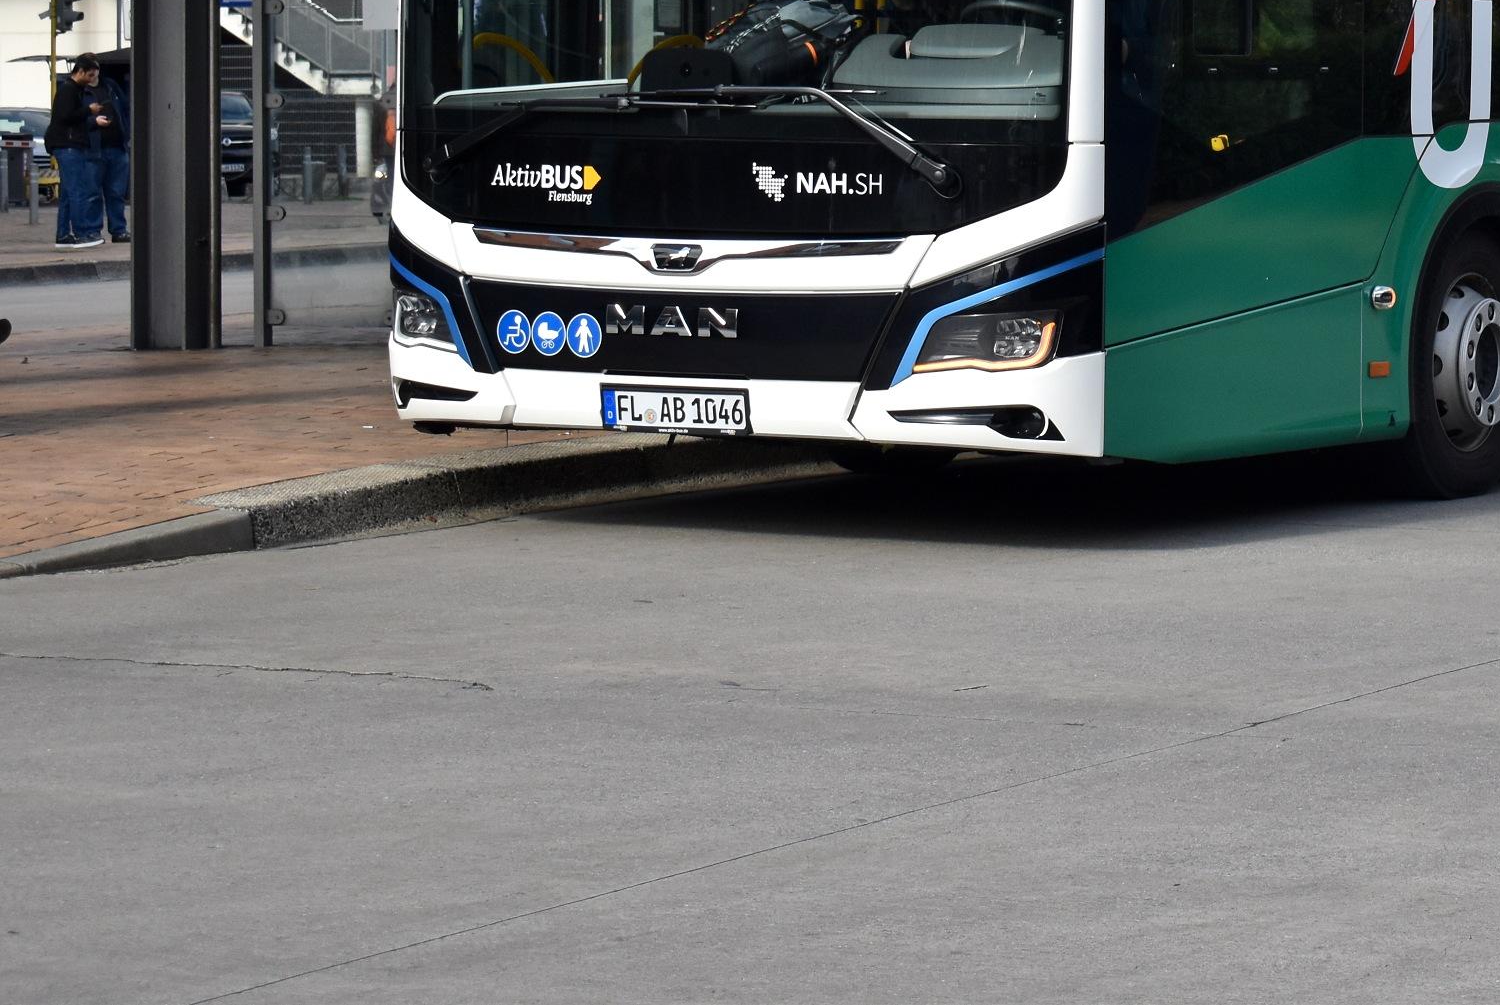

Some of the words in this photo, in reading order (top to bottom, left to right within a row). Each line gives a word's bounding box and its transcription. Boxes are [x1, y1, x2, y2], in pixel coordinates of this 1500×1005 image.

[490, 162, 584, 190] AktivBUS
[796, 172, 883, 195] NAH.SH
[548, 191, 593, 206] Flensburg
[605, 303, 739, 338] MAN
[607, 410, 614, 419] D
[617, 395, 643, 422] FL
[660, 396, 686, 423] AB
[691, 397, 744, 425] 1046
